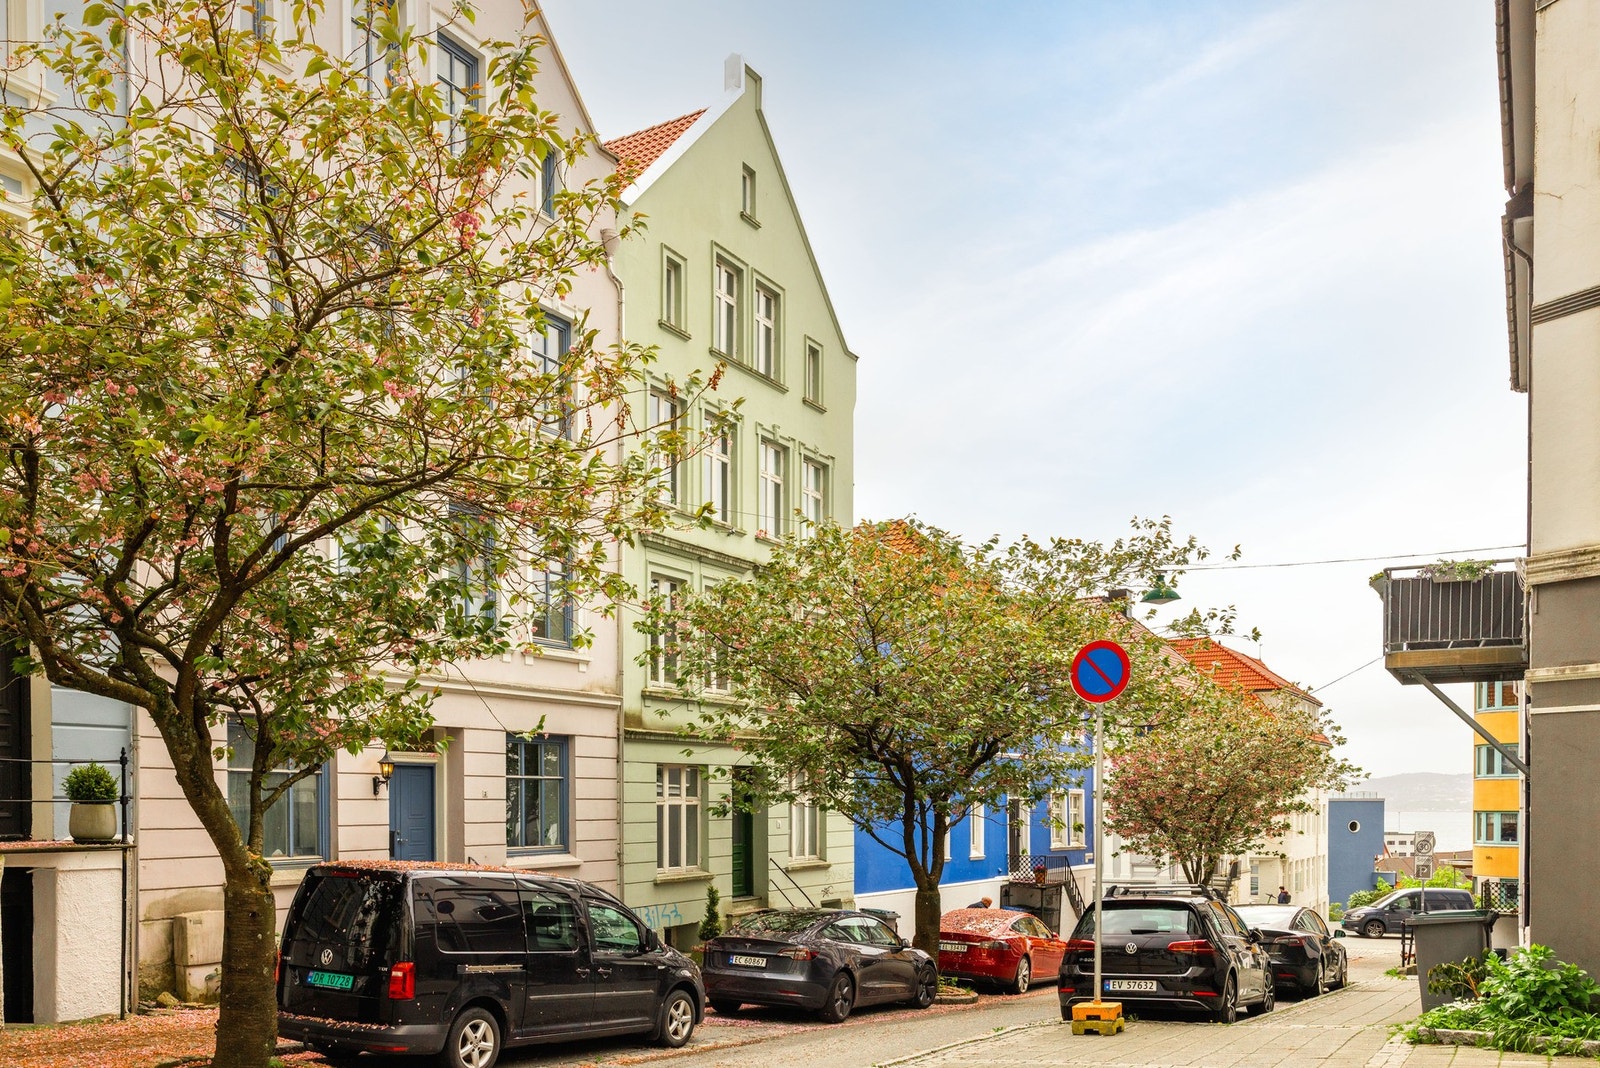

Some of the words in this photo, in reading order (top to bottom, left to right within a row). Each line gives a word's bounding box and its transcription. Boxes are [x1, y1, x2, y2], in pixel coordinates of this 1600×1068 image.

[313, 972, 324, 983] DR
[327, 974, 351, 987] 10728
[1112, 981, 1123, 989] EV
[1127, 982, 1154, 990] 57632
